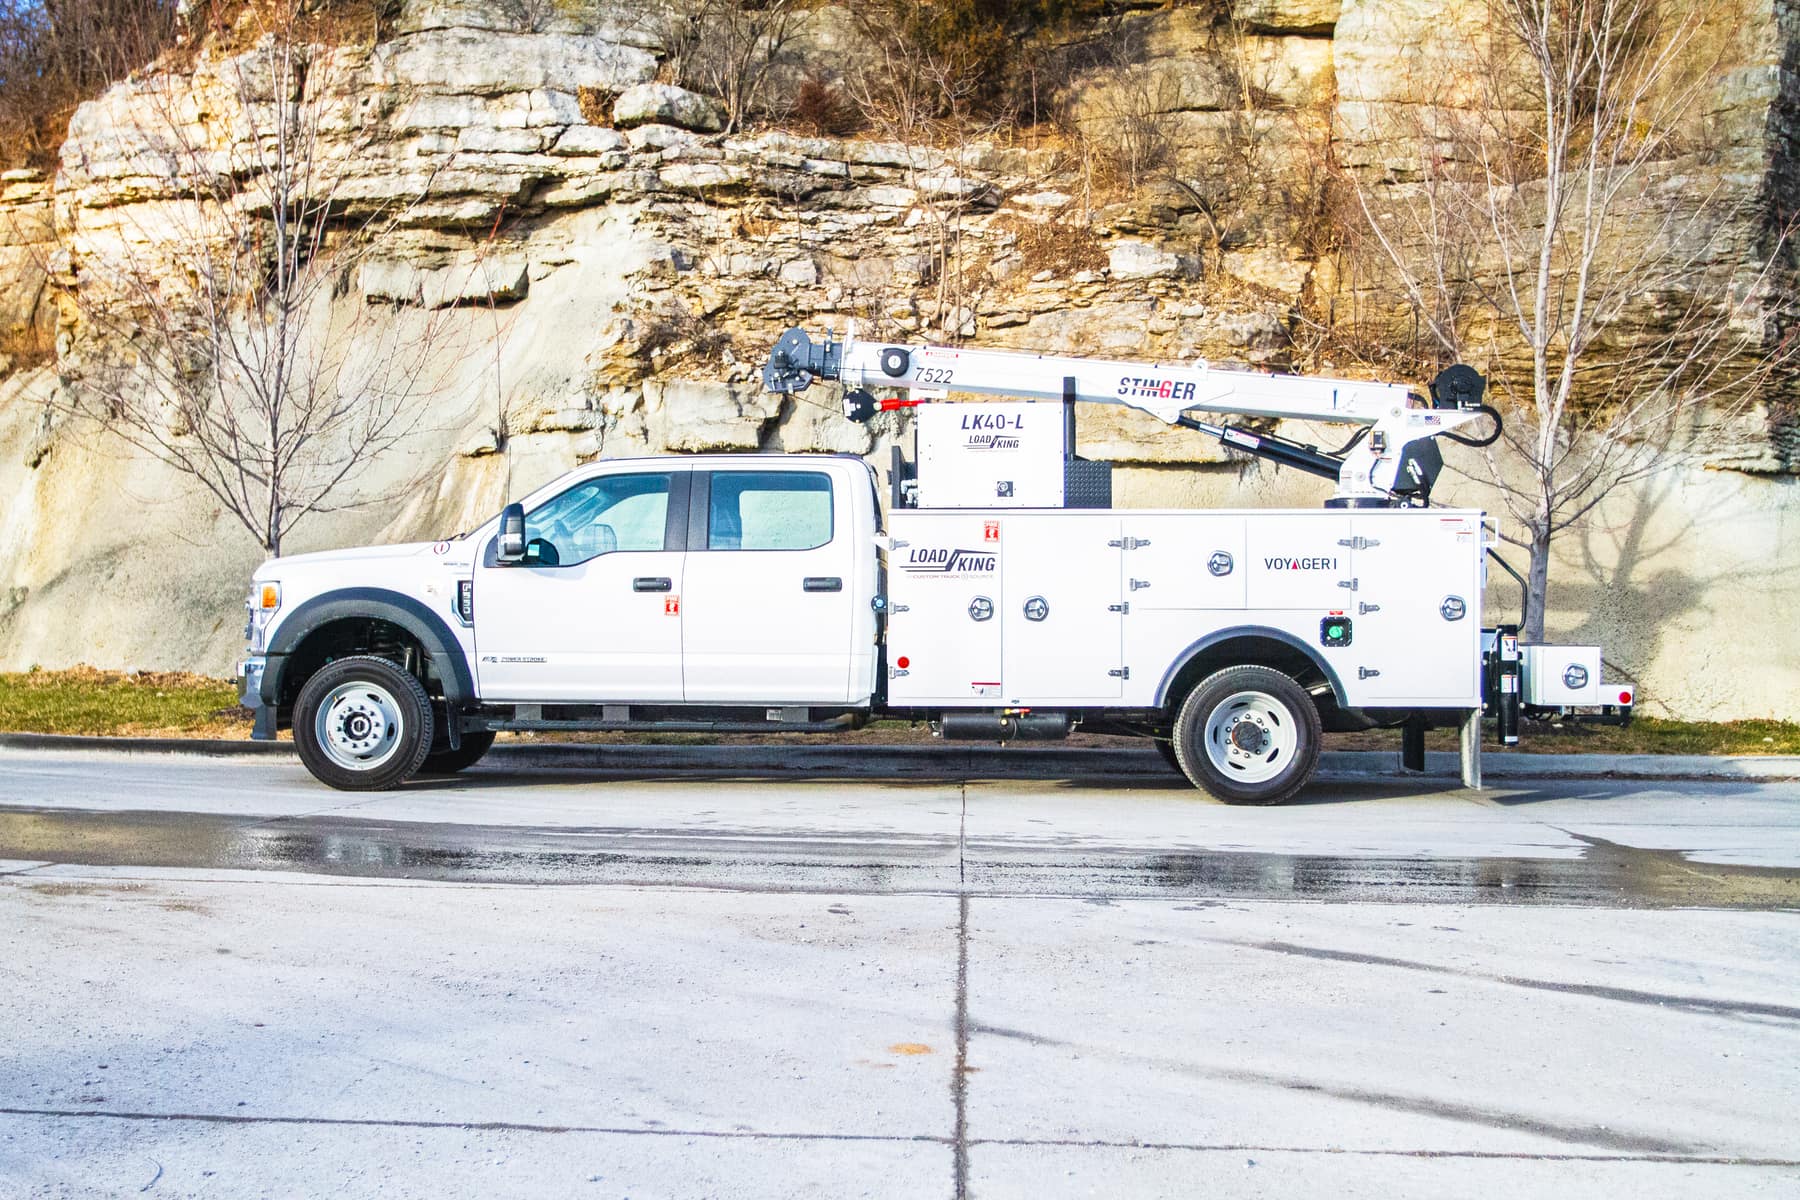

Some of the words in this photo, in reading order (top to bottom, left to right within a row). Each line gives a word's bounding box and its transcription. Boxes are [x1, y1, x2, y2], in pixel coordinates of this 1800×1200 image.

[915, 367, 954, 384] 7522
[1117, 376, 1196, 400] STINGER
[961, 414, 1024, 430] LK40-L
[968, 434, 992, 444] LOAD
[996, 439, 1020, 449] KING
[909, 548, 948, 563] LOAD
[957, 557, 996, 572] KING
